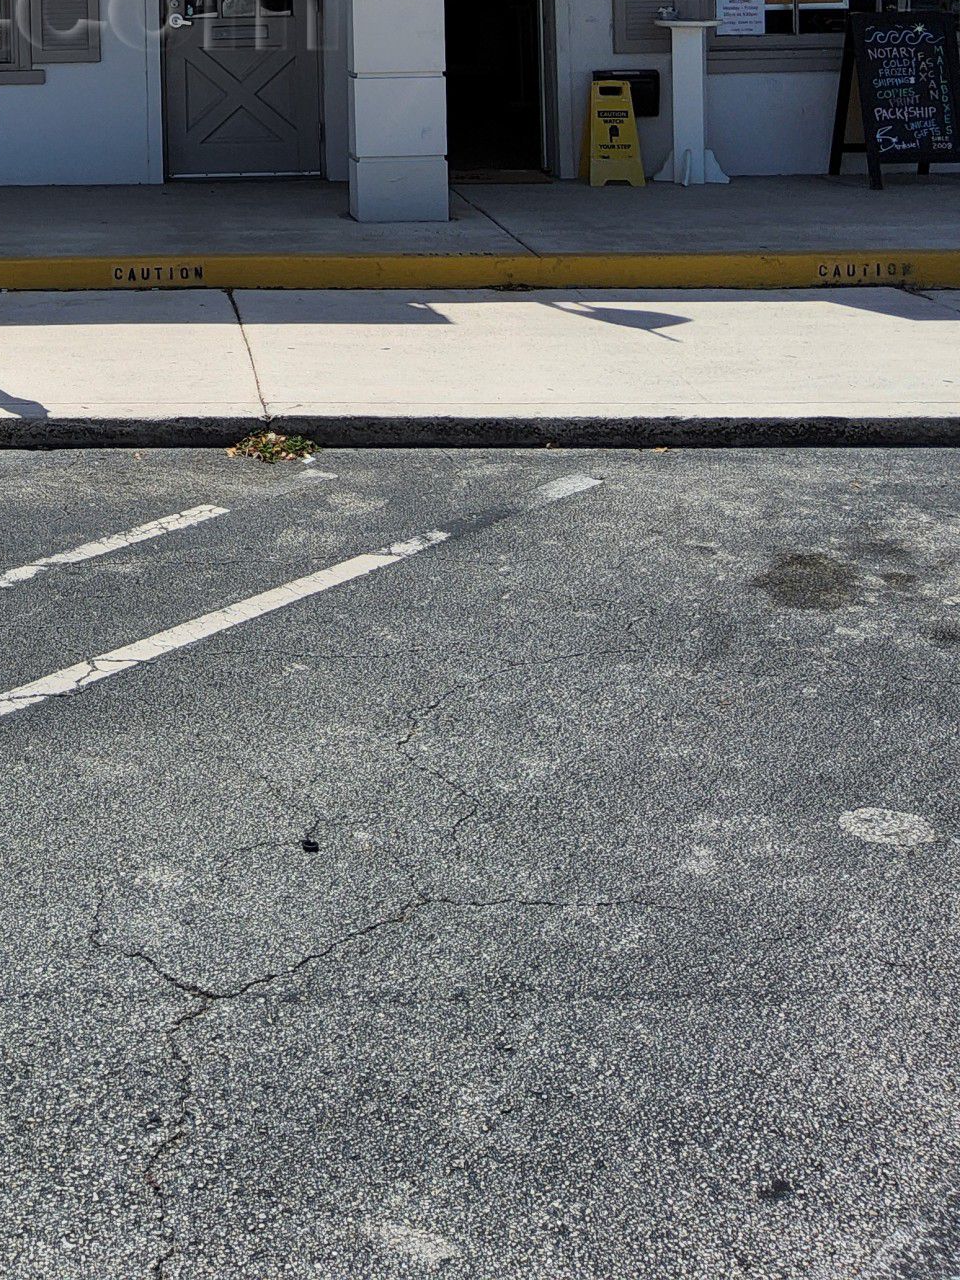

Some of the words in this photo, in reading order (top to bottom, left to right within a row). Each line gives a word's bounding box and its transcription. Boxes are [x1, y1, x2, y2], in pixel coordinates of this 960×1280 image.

[867, 46, 916, 61] NOTARY
[882, 60, 909, 69] COLD
[917, 52, 928, 82] FAX
[878, 67, 916, 78] FROZEN
[925, 58, 939, 100] SCAN
[876, 87, 916, 99] COPIES
[934, 46, 953, 135] MAILBOXES
[913, 128, 941, 140] GIFTS
[932, 142, 953, 150] 2008
[114, 266, 204, 281] CAUTION
